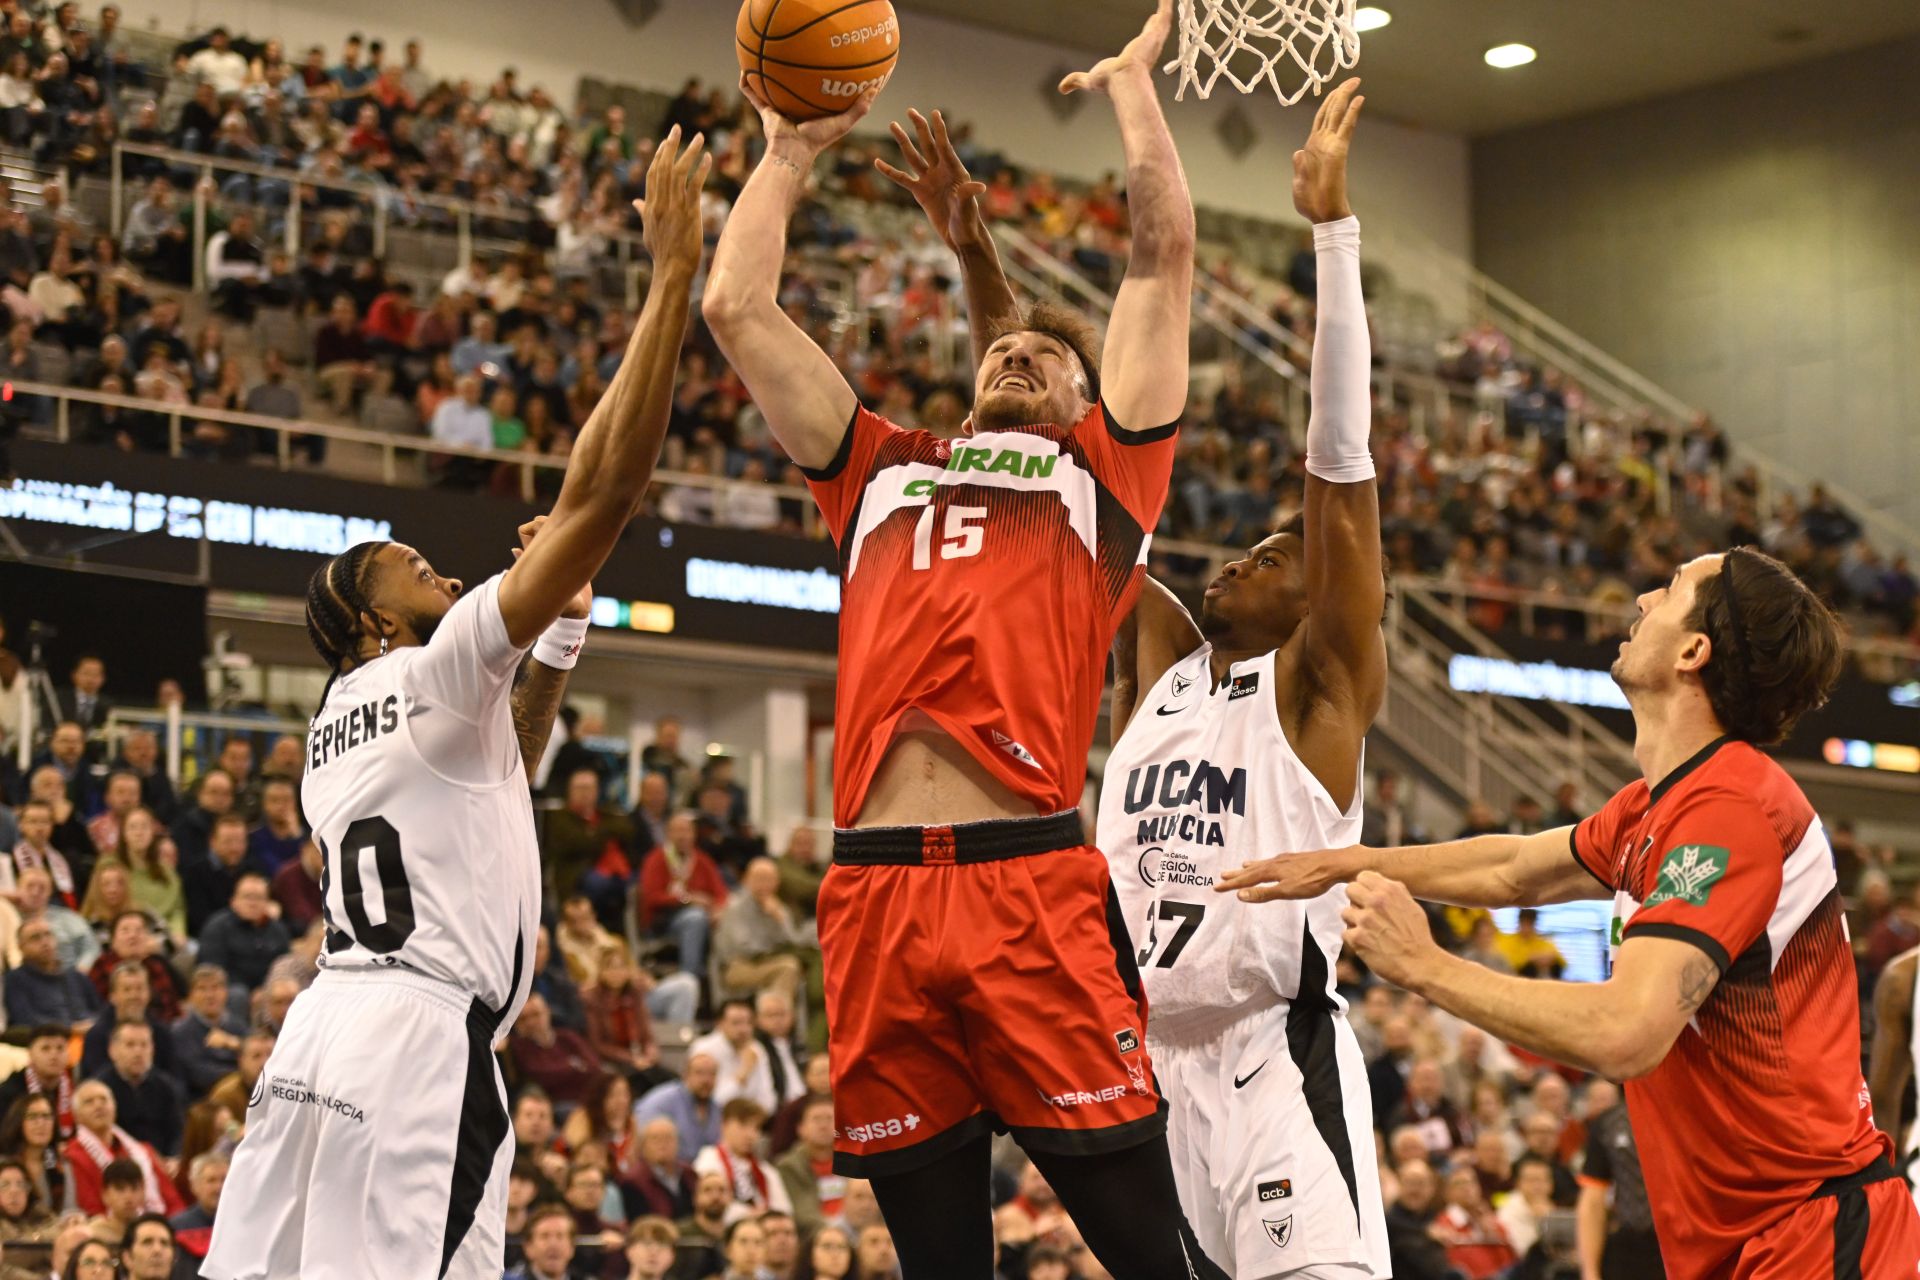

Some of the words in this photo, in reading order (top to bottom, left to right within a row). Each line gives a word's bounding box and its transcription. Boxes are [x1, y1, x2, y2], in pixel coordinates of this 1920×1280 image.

[913, 505, 988, 571] 15
[306, 694, 399, 775] EPHENS
[1124, 760, 1247, 818] UCAM
[1167, 872, 1214, 887] MURCIA
[1120, 1038, 1135, 1051] acb
[1261, 1187, 1286, 1200] acb
